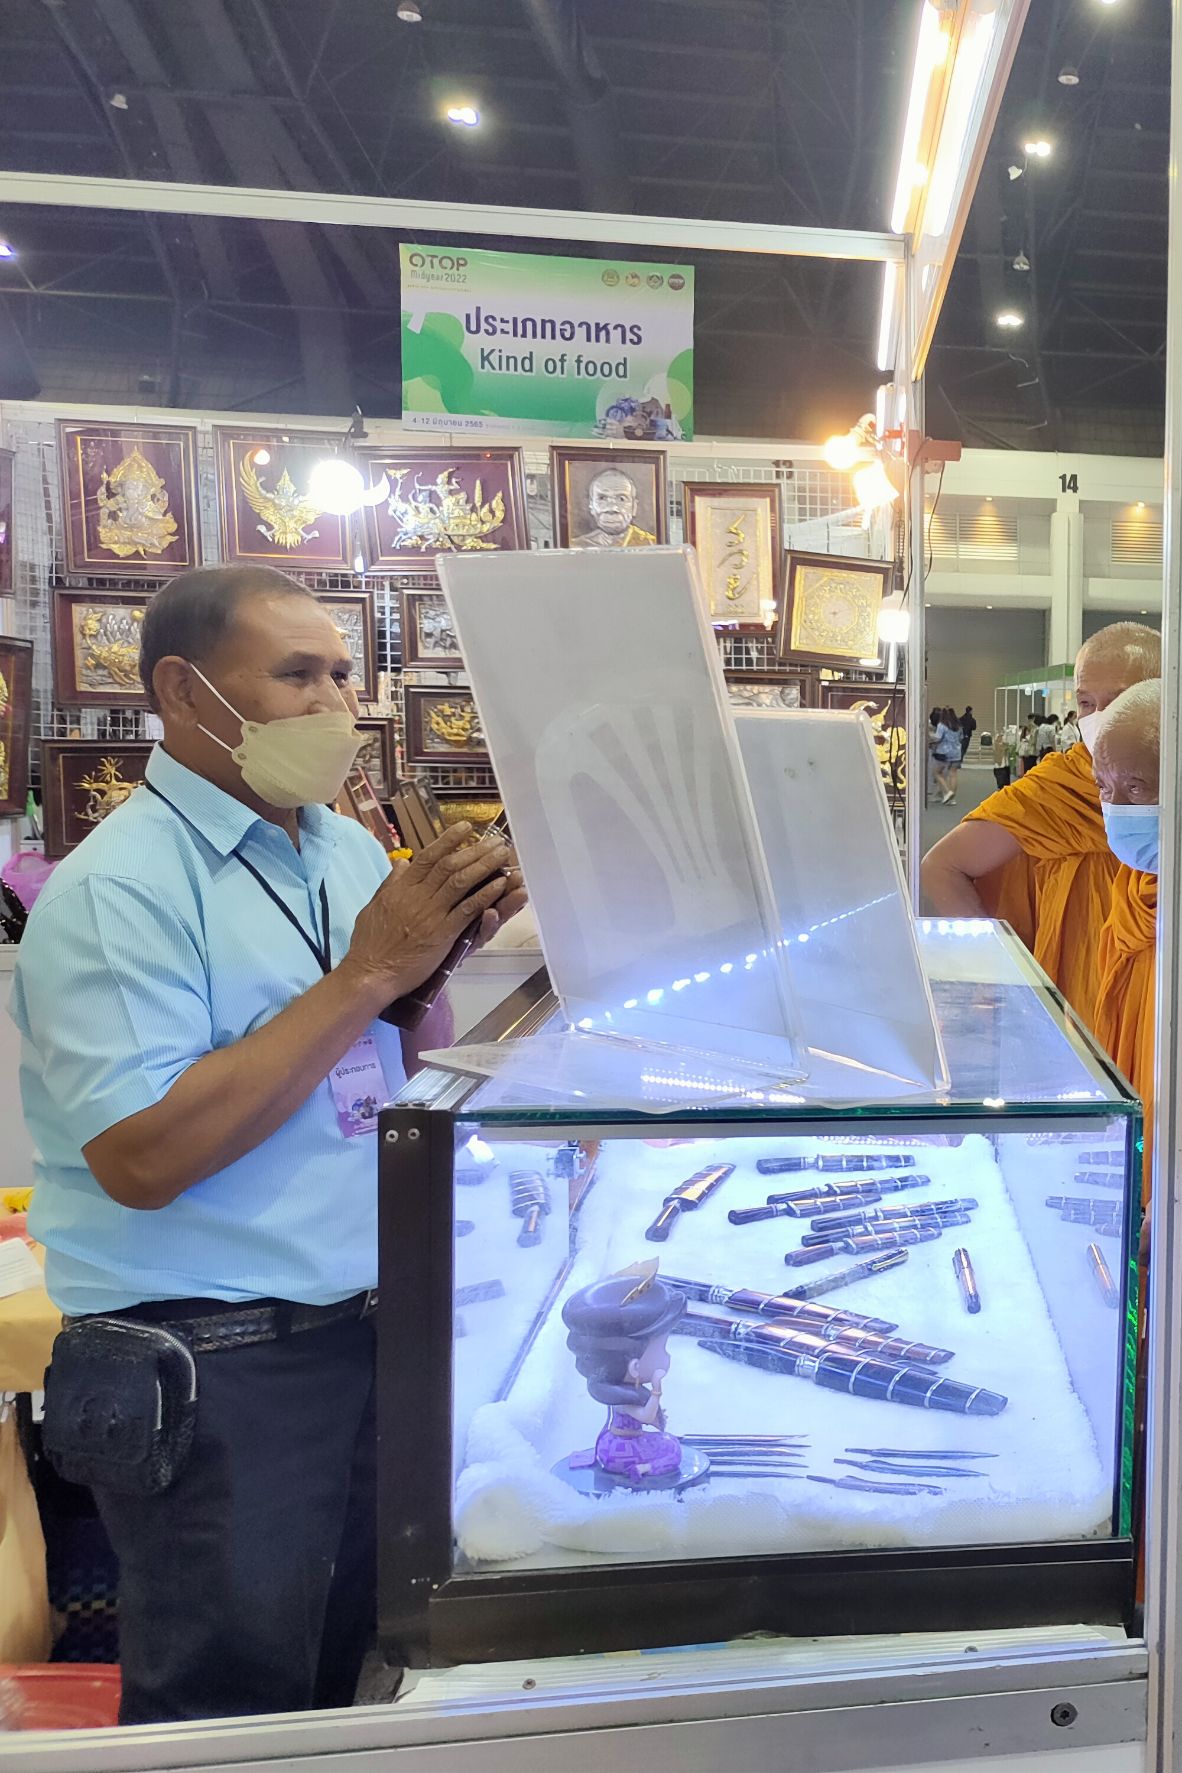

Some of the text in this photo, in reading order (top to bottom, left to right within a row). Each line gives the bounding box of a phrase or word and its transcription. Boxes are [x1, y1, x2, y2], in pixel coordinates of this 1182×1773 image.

[409, 252, 468, 271] OTOP
[465, 306, 643, 346] ประเภทอาหาร
[479, 347, 628, 378] Kind of food
[465, 420, 484, 428] 2565
[772, 460, 794, 480] 13
[1058, 473, 1079, 494] 14
